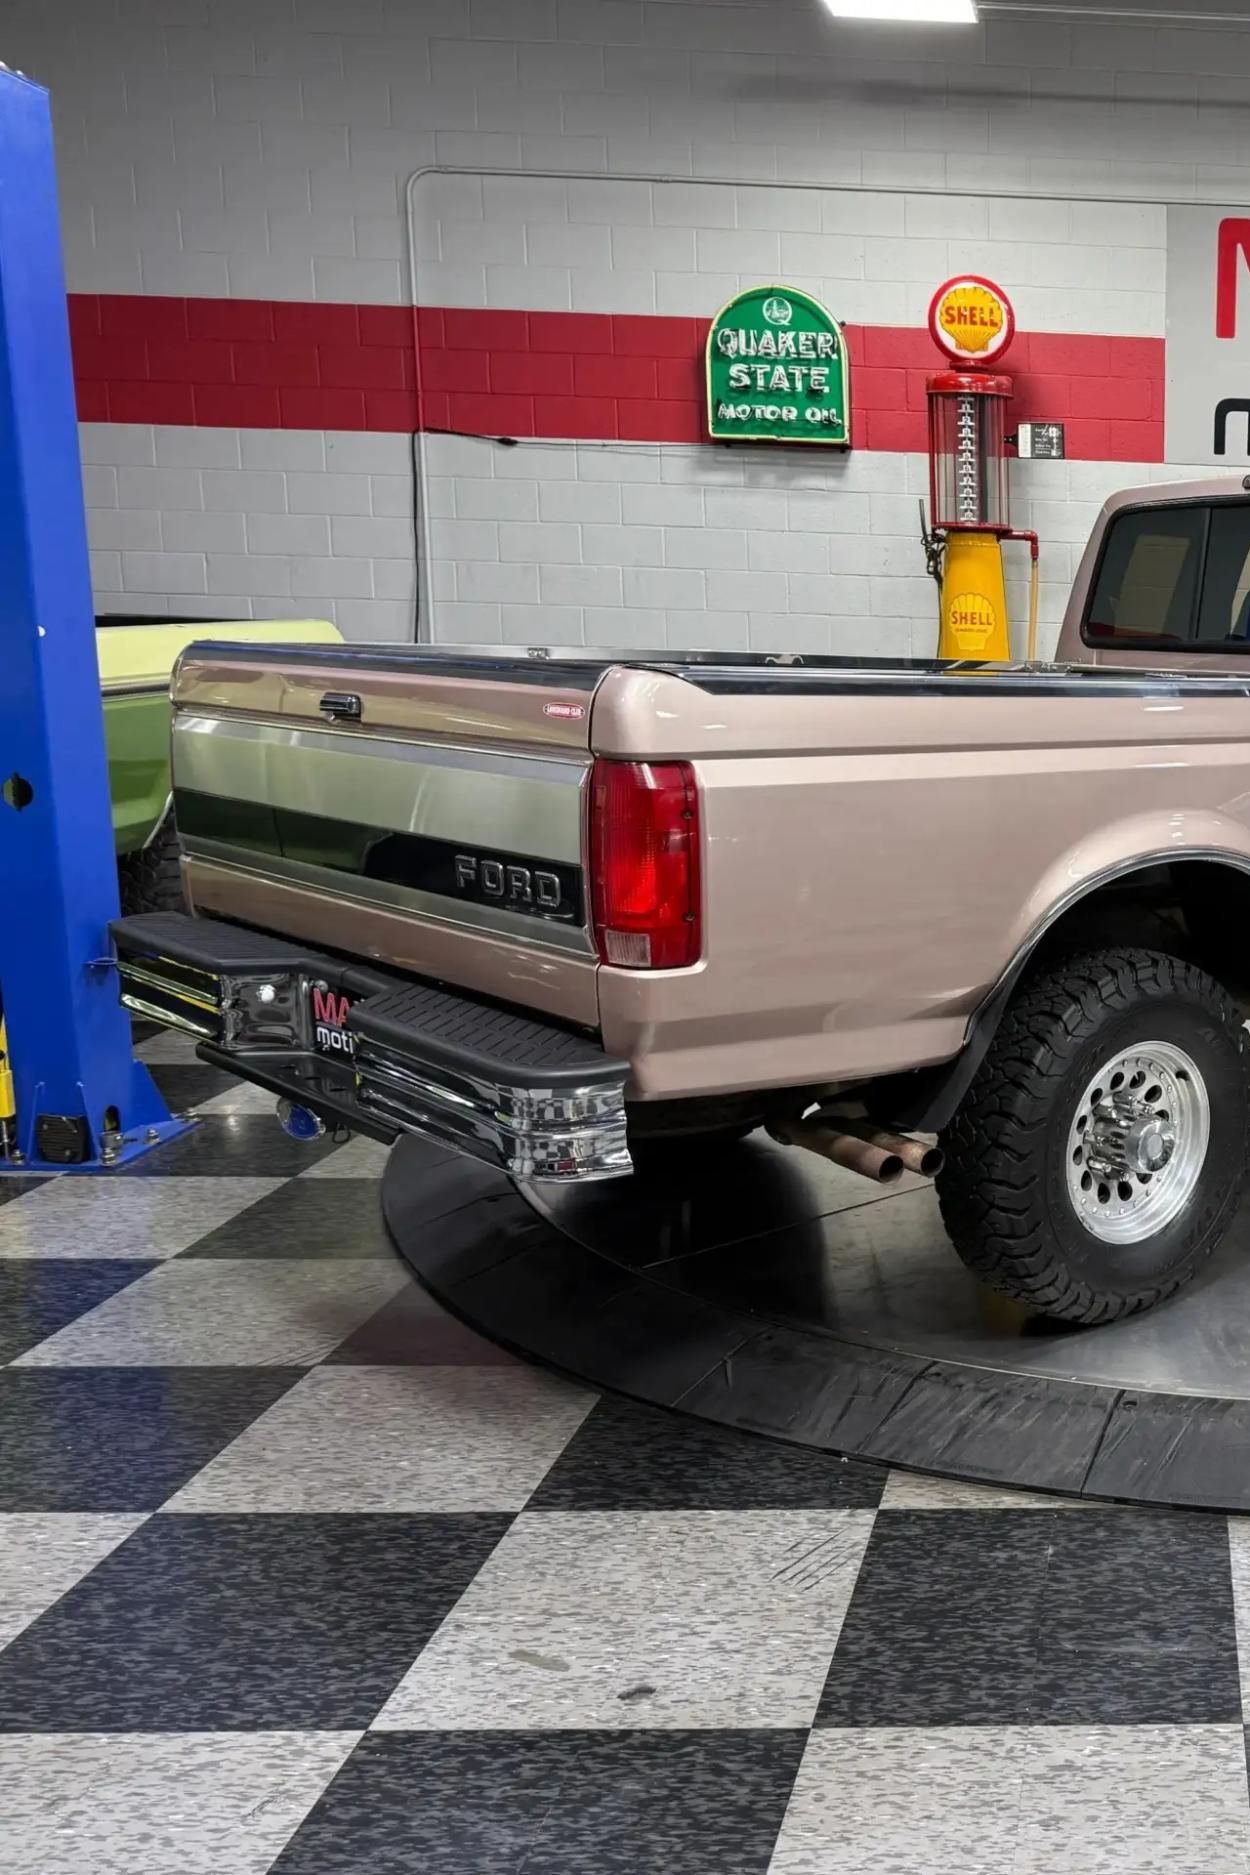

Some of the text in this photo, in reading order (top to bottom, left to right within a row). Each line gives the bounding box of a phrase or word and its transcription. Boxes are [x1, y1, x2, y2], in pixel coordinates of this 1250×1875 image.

[944, 305, 999, 327] SHELL
[717, 328, 839, 360] QUAKER
[728, 363, 830, 394] STATE
[717, 403, 842, 424] MOTOR OIL
[951, 611, 993, 626] SHELL
[455, 854, 561, 908] FORD
[312, 987, 350, 1027] MA
[316, 1026, 354, 1054] moti
